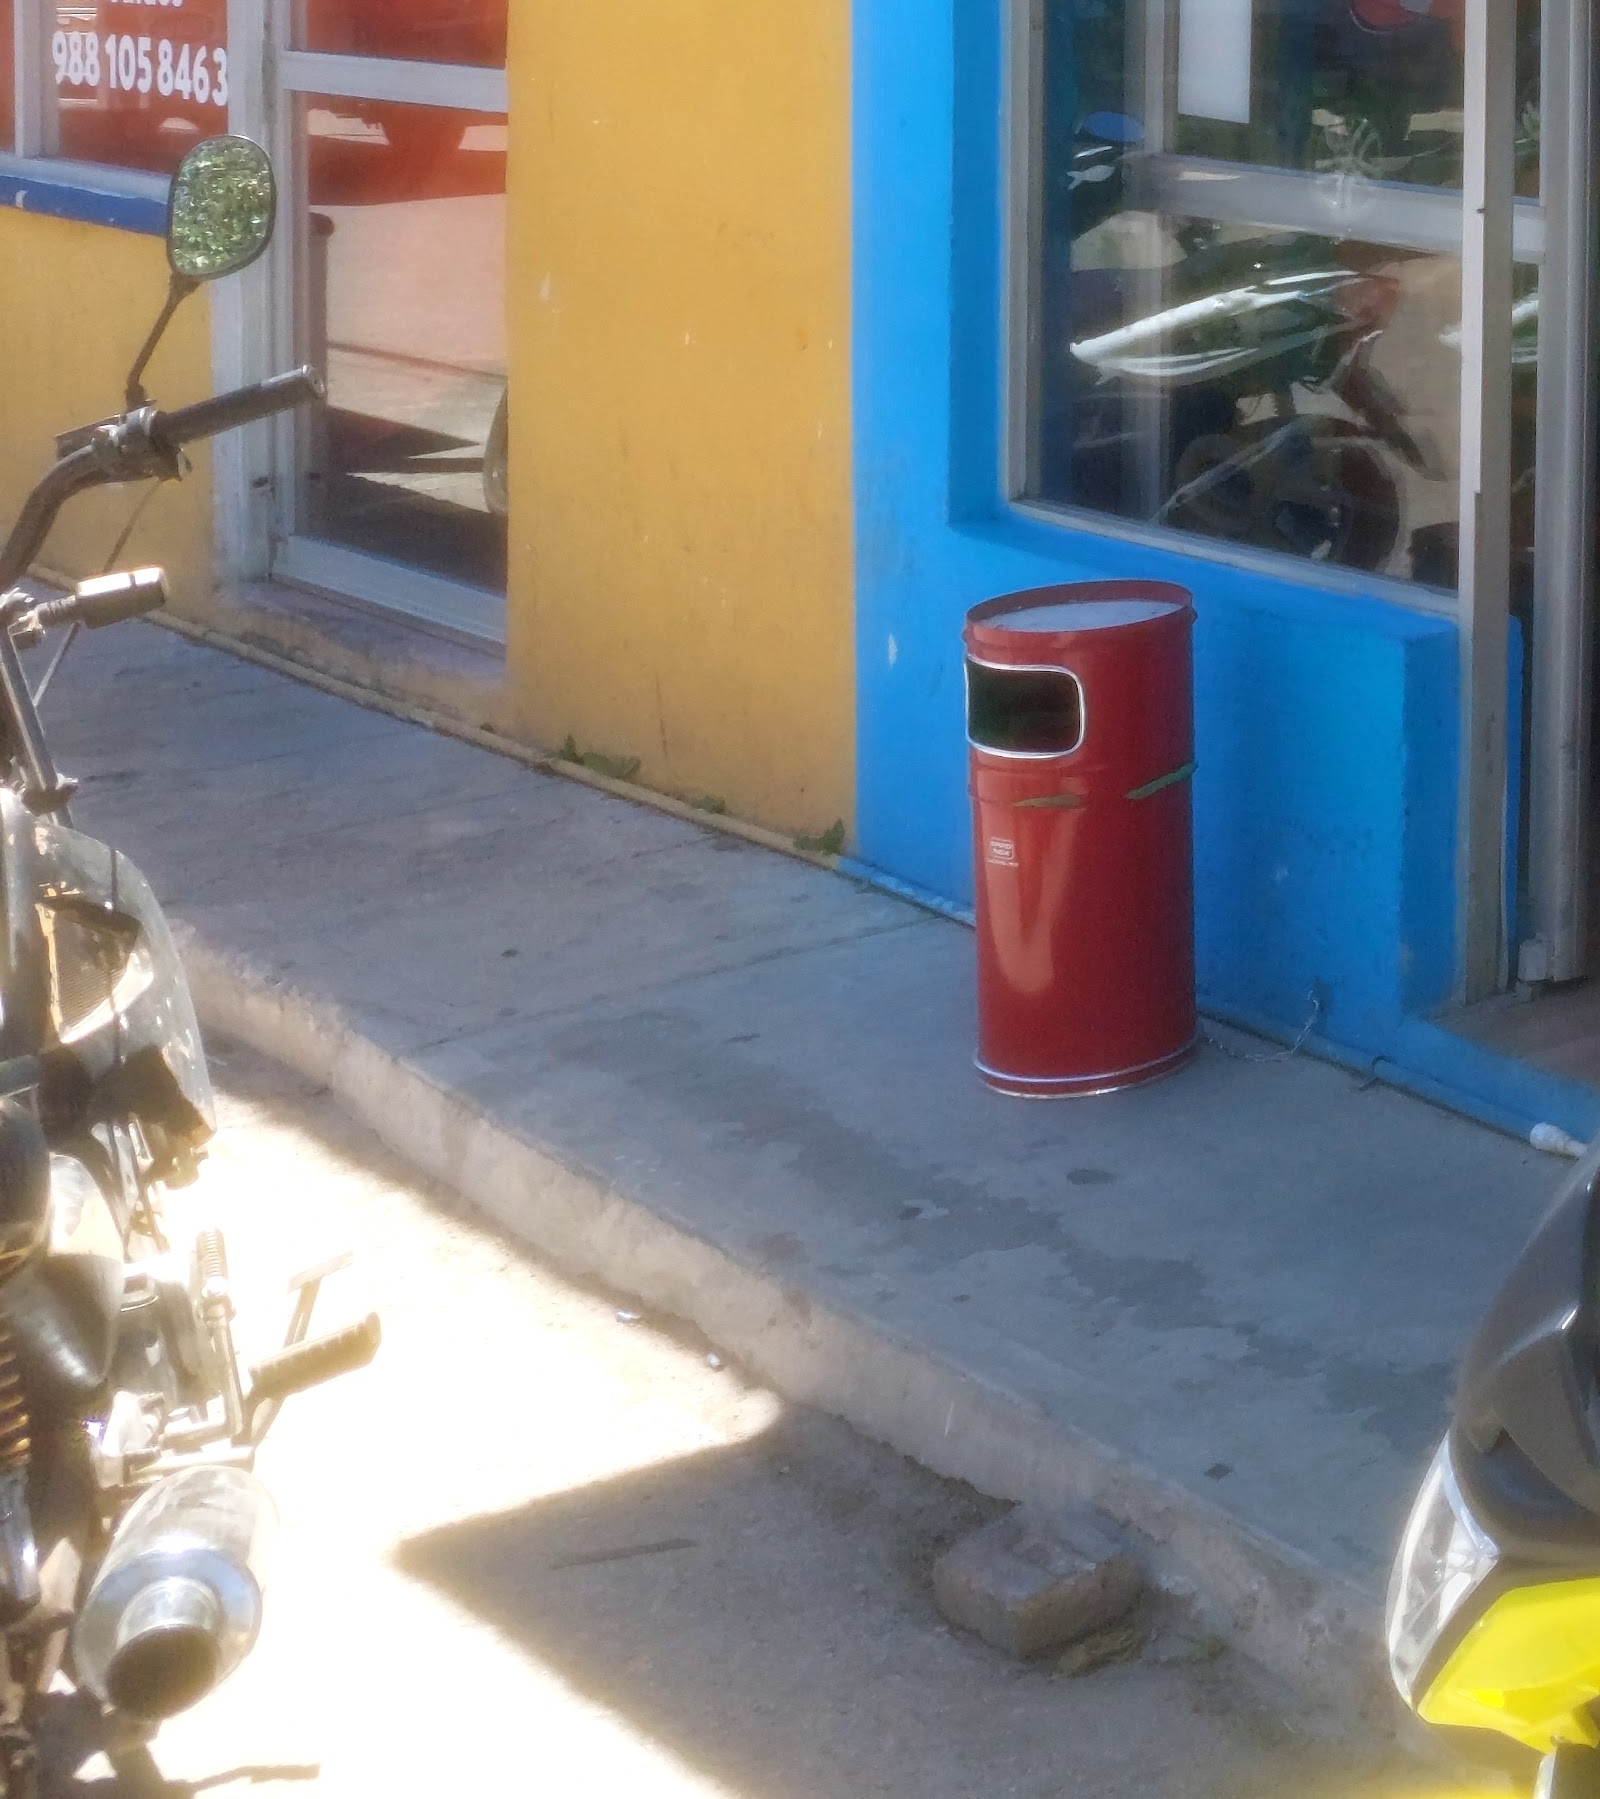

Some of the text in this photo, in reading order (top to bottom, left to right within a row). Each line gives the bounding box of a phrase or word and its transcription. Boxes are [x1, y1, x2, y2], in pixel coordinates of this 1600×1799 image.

[52, 30, 228, 107] 988 105 8463
